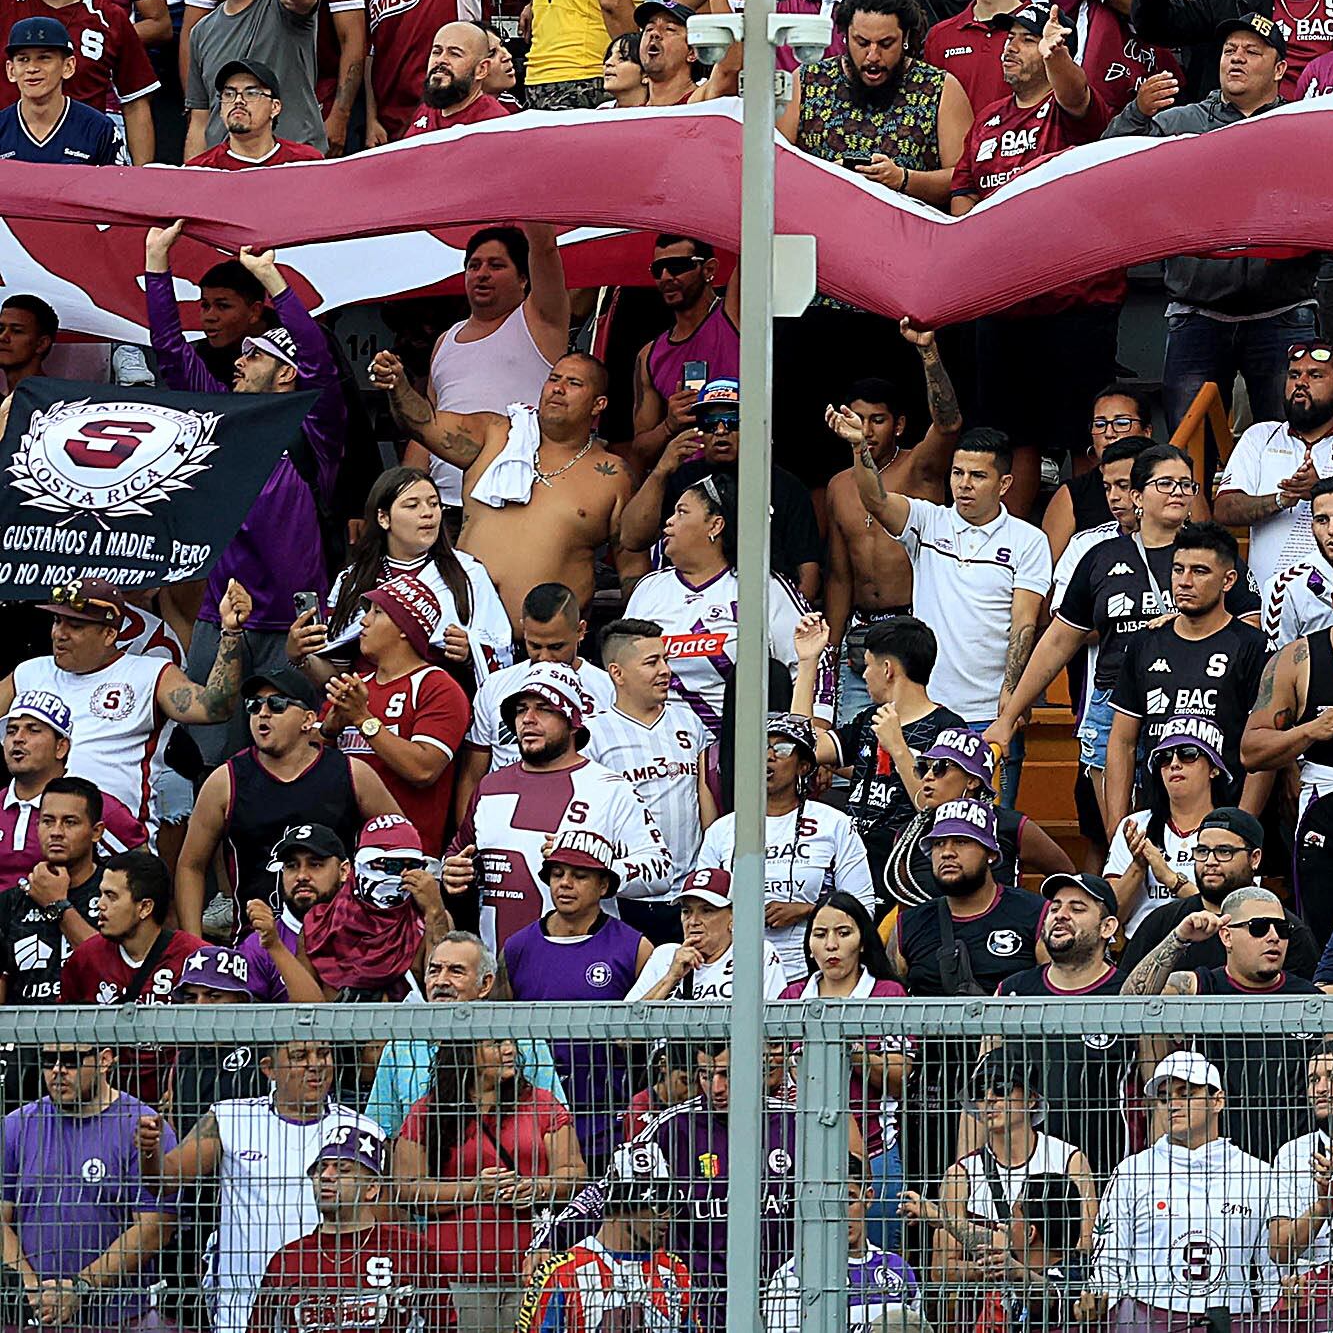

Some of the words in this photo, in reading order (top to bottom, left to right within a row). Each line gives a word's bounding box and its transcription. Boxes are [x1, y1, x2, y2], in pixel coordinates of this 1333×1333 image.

[1297, 20, 1333, 34] BAC
[945, 47, 972, 58] joma
[1001, 128, 1038, 150] BAC
[63, 419, 156, 469] S
[31, 457, 95, 506] COSTA
[106, 468, 164, 505] RICA
[3, 525, 87, 555] GUSTAMOS
[89, 531, 101, 556] A
[170, 540, 210, 566] PERO
[14, 564, 38, 585] NO
[41, 564, 75, 586] NOS
[1176, 690, 1218, 709] BAC
[1174, 708, 1215, 716] CREDOMATIC
[764, 844, 810, 861] BAC
